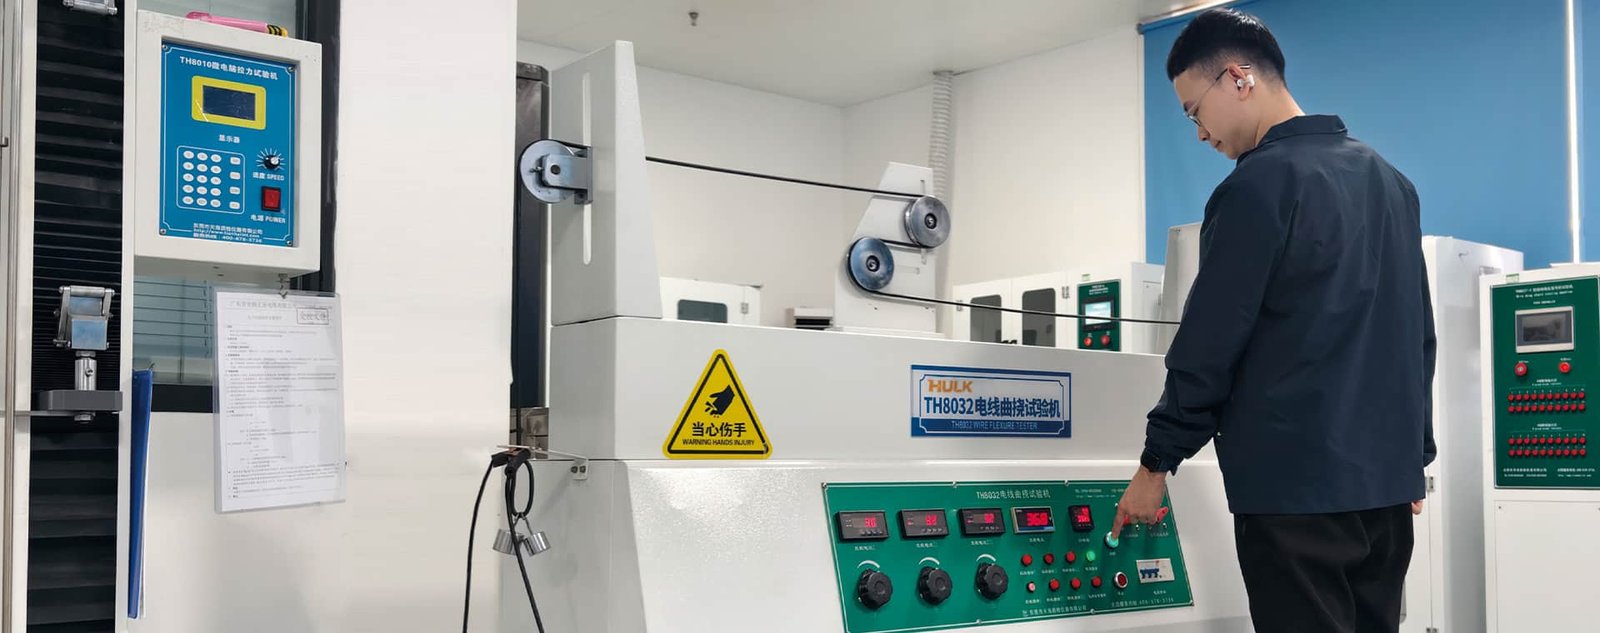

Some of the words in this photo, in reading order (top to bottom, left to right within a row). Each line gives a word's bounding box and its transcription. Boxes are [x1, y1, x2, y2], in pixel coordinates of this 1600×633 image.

[265, 215, 286, 224] POWER
[927, 379, 973, 393] HULK
[692, 421, 747, 438] 当心伤手
[974, 421, 988, 429] WIRE
[989, 422, 1015, 430] FLEXURE
[1015, 422, 1038, 430] TESTER
